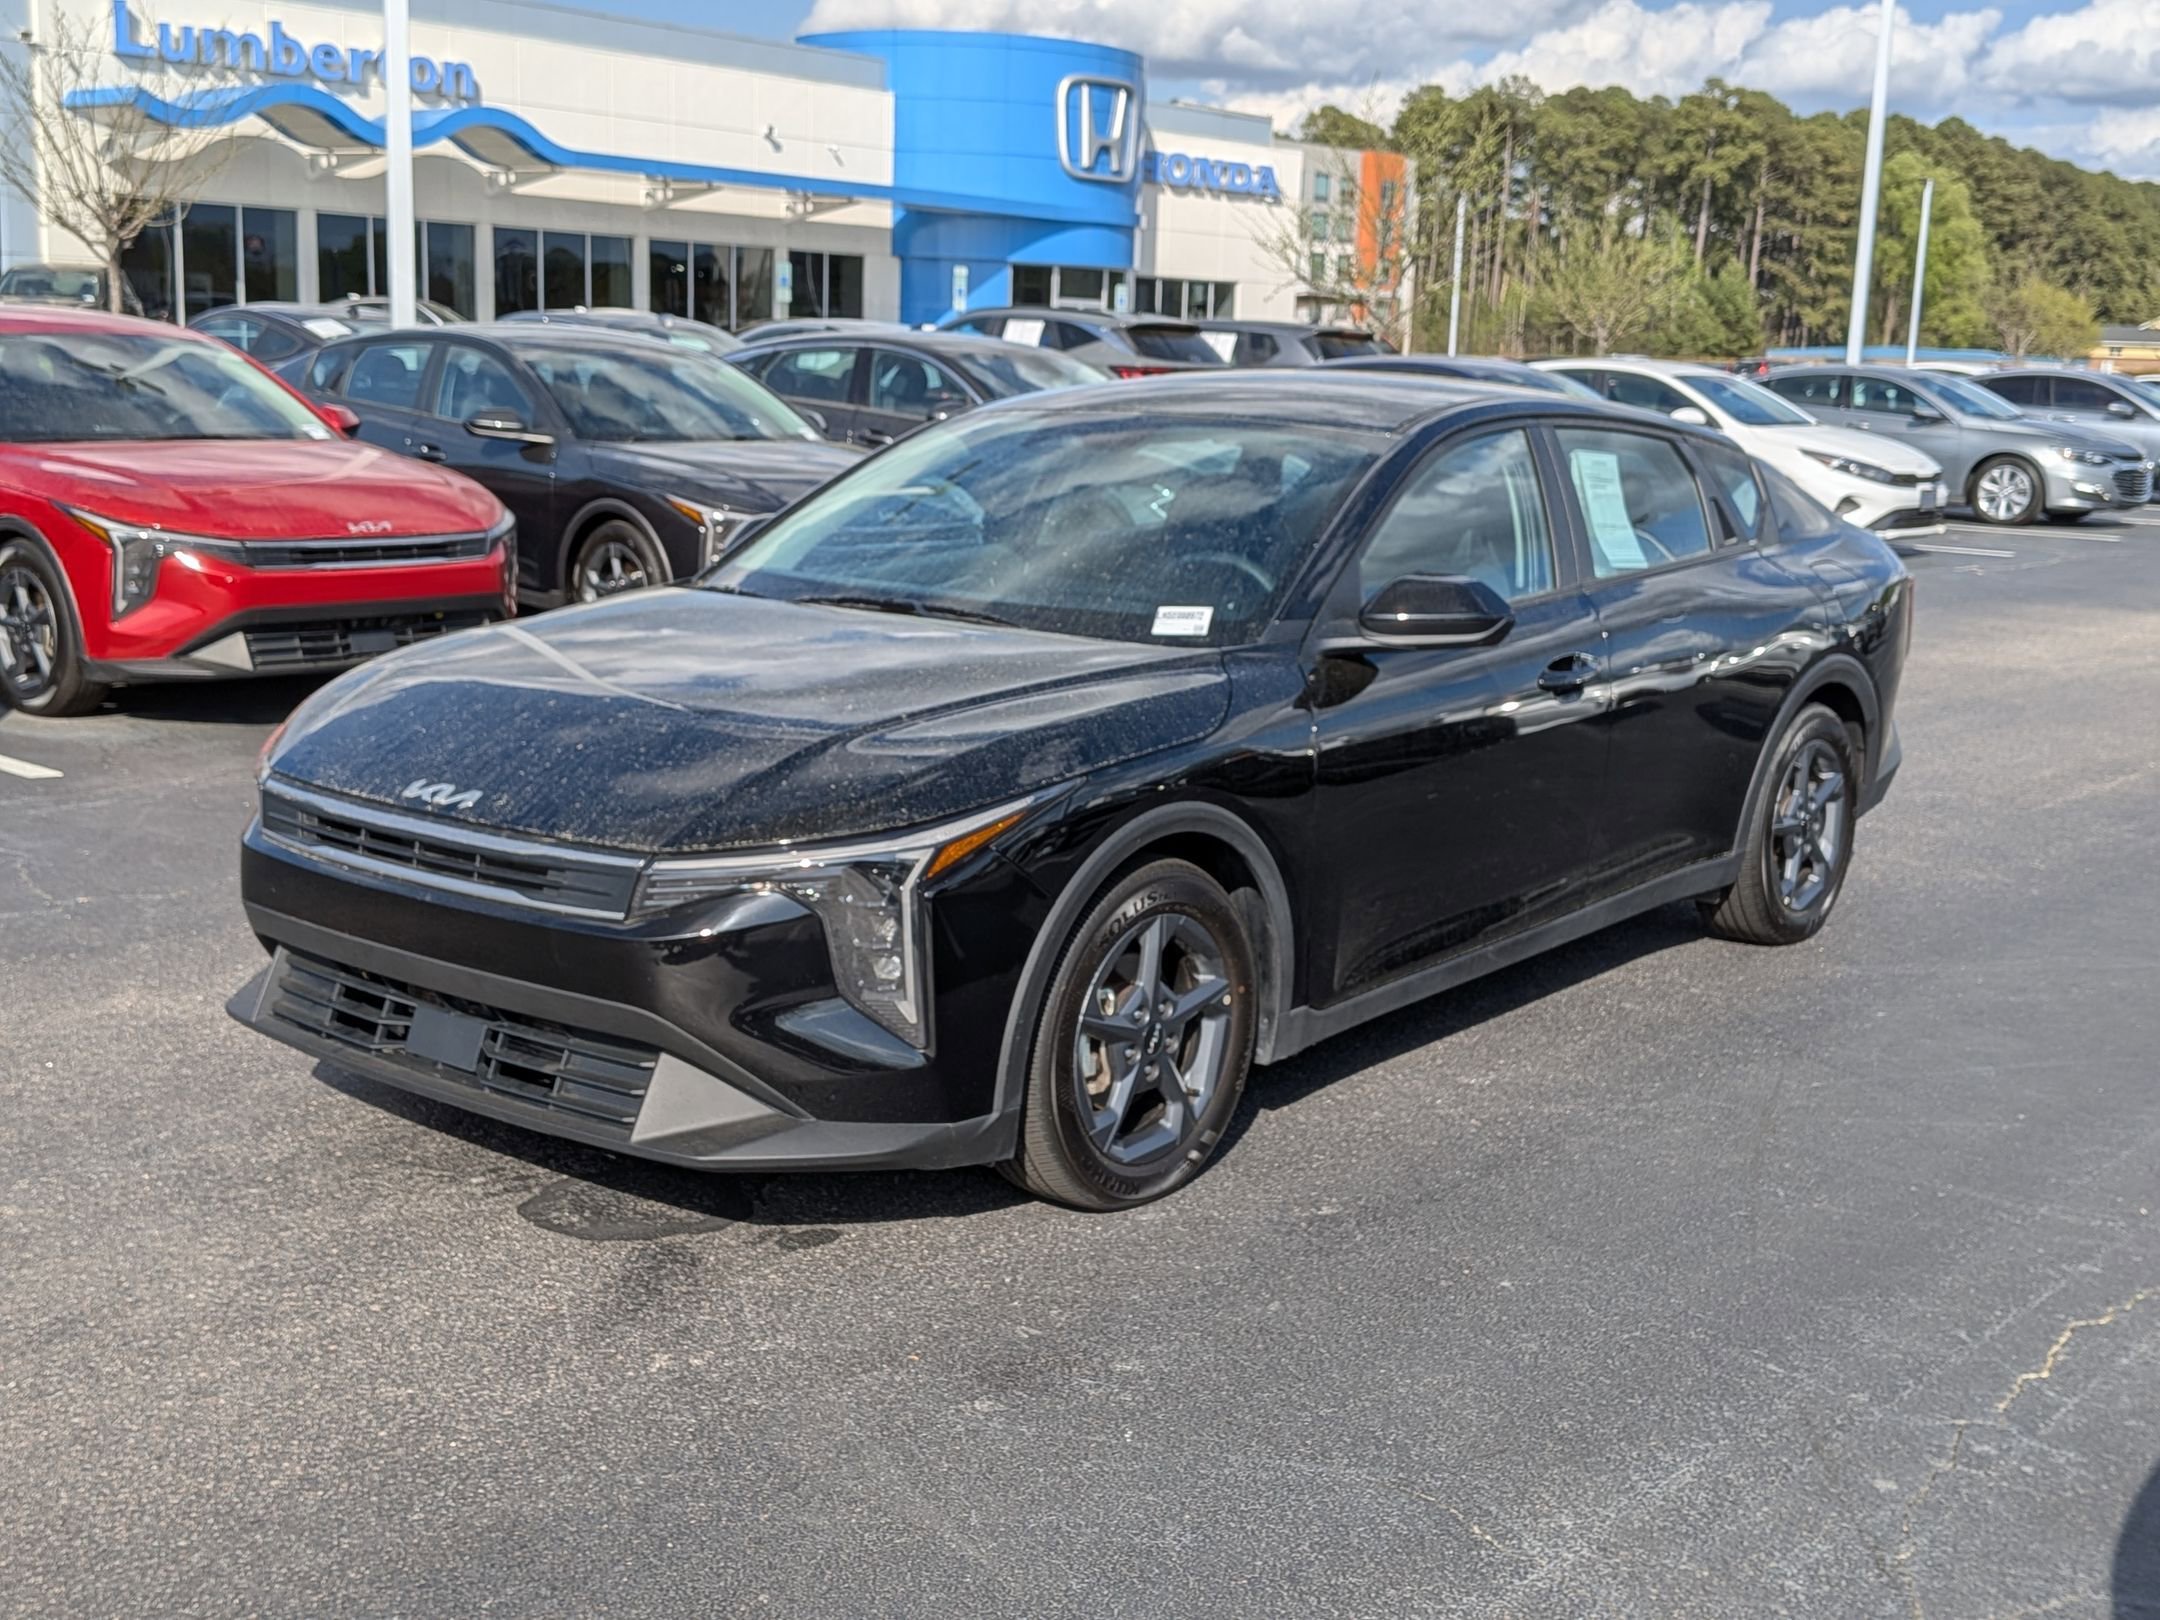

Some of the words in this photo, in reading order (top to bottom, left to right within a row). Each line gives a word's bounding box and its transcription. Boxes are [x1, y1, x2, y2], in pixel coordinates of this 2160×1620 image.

[1143, 151, 1282, 198] HONDA
[401, 778, 484, 810] KIA
[1099, 891, 1158, 947] SOLUS
